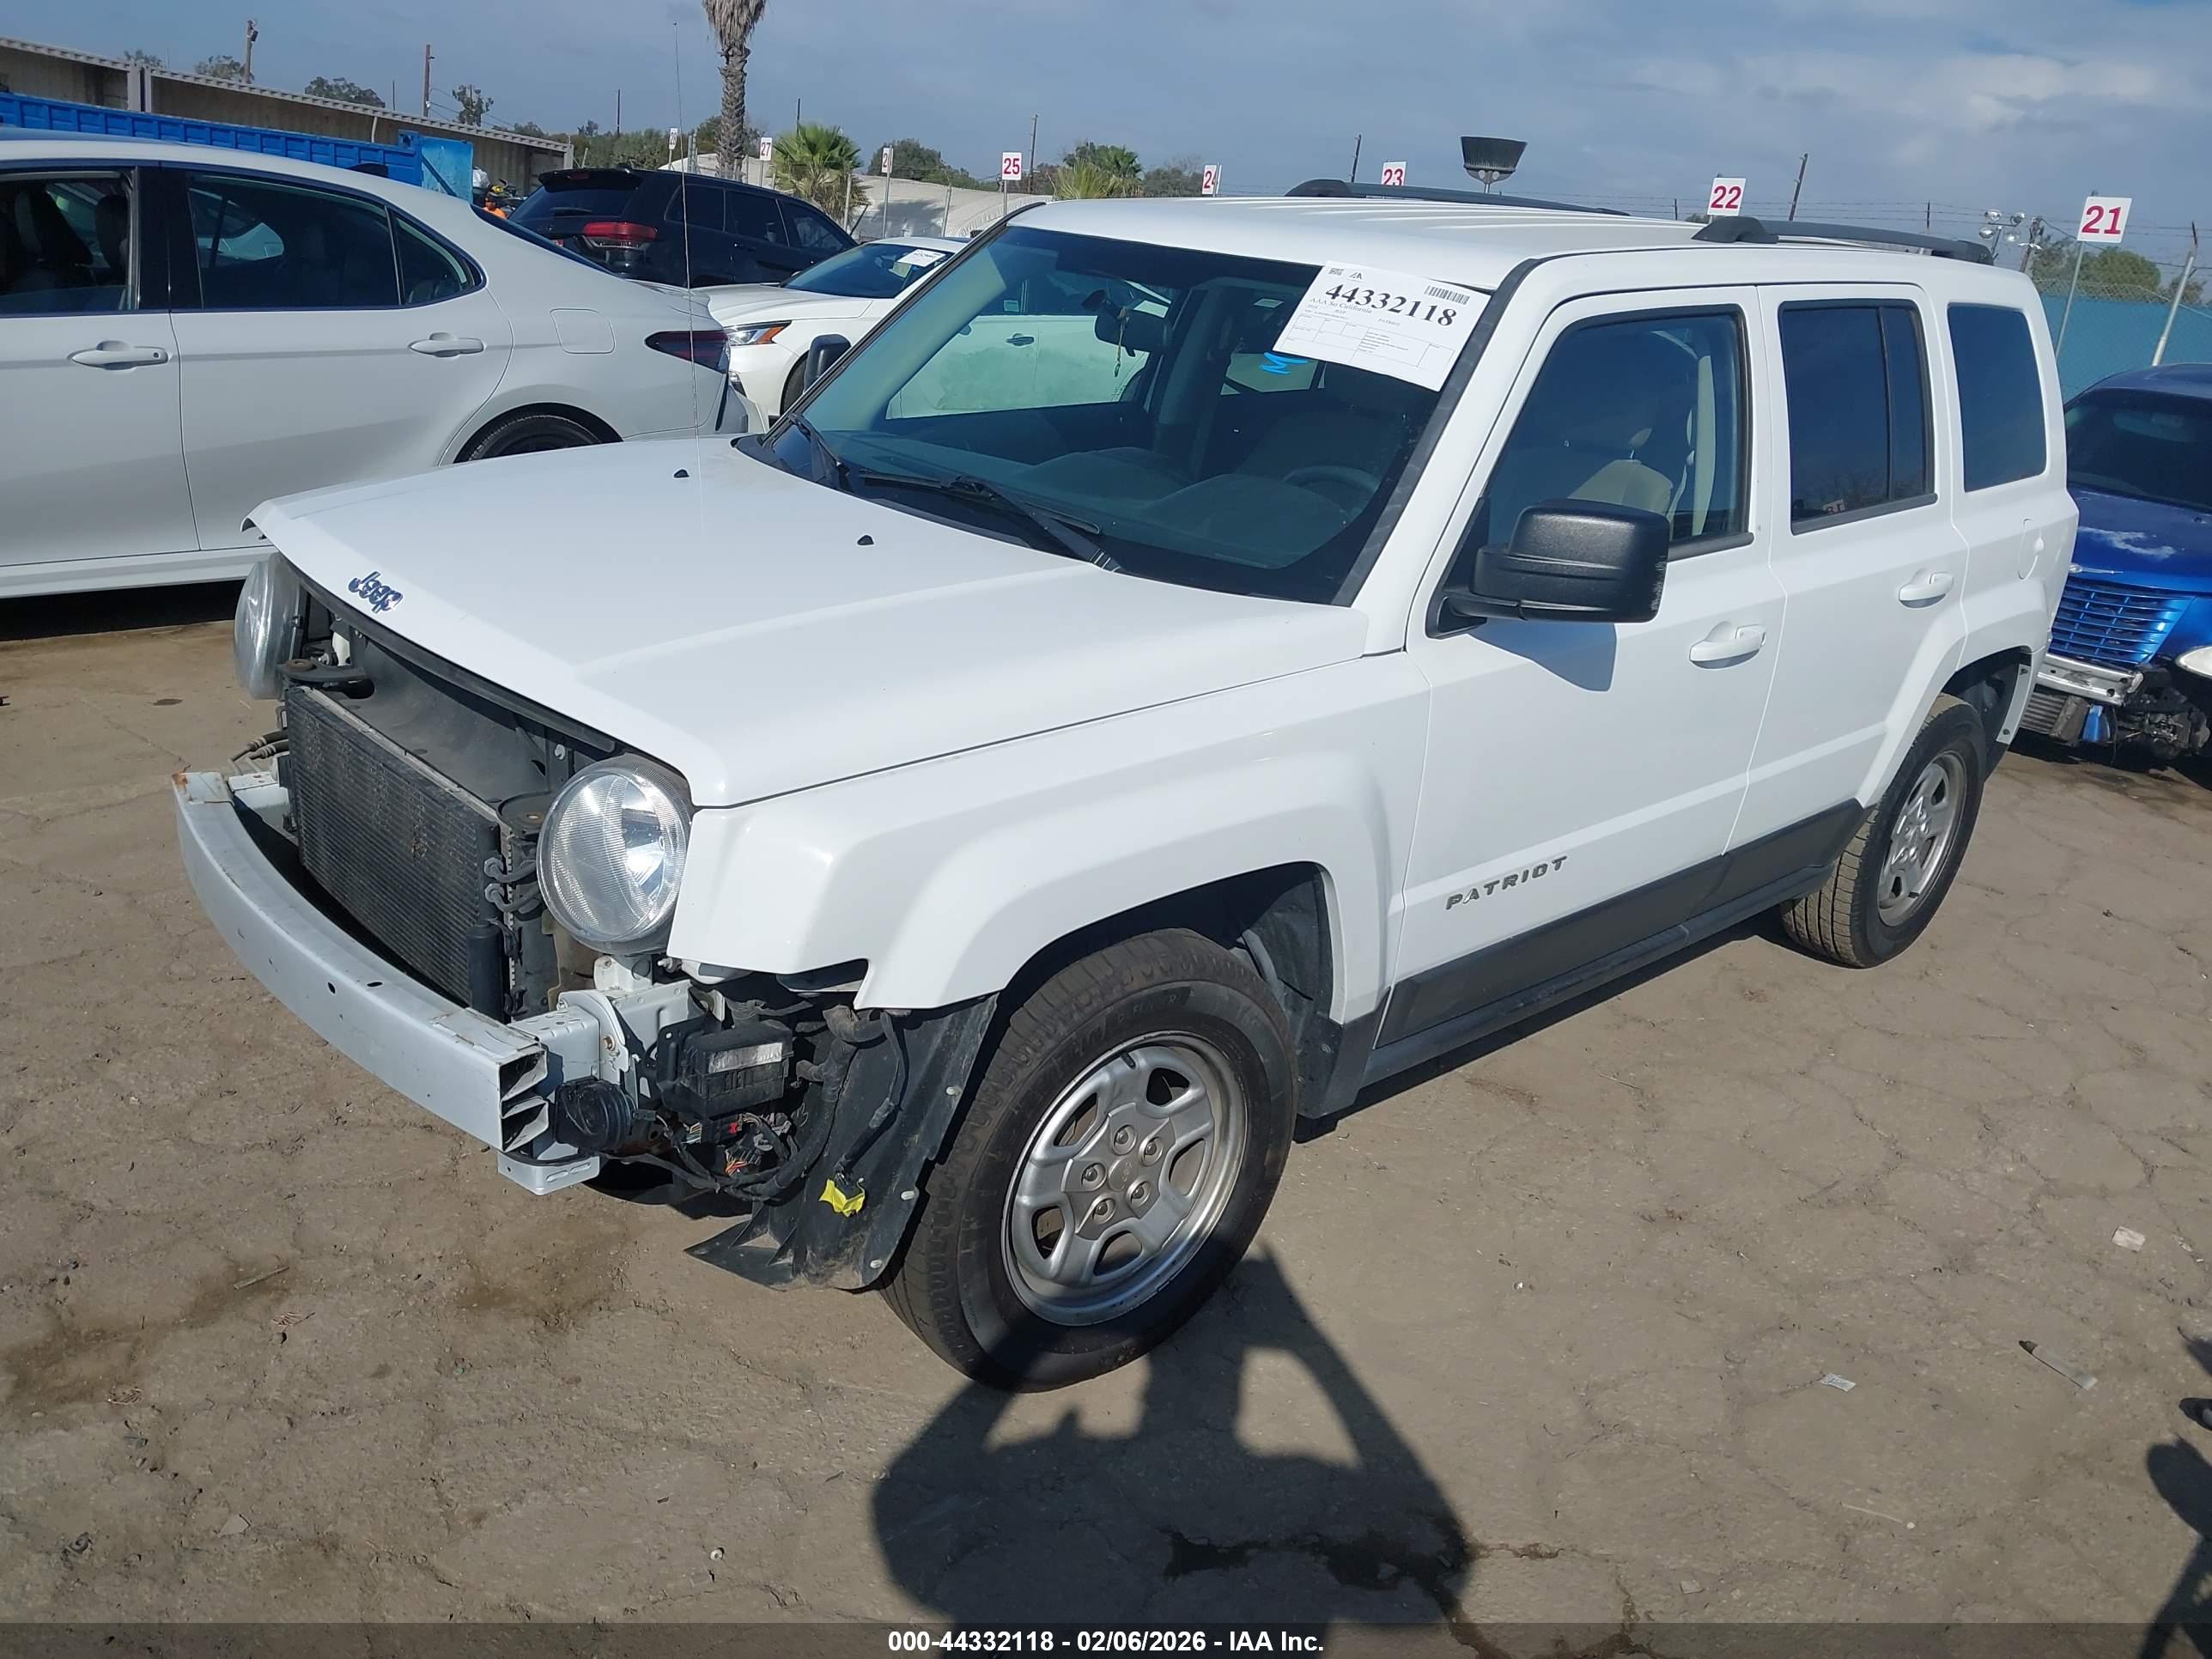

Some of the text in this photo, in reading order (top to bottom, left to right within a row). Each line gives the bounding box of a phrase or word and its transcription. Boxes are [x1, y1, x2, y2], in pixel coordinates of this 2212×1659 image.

[761, 142, 771, 156] 27
[1003, 158, 1020, 174] 25
[1383, 168, 1403, 185] 23
[1711, 185, 1741, 209] 22
[2081, 205, 2122, 234] 21
[1325, 284, 1457, 326] 44332118
[348, 570, 404, 613] Jeep
[1445, 855, 1568, 910] PATRIOT
